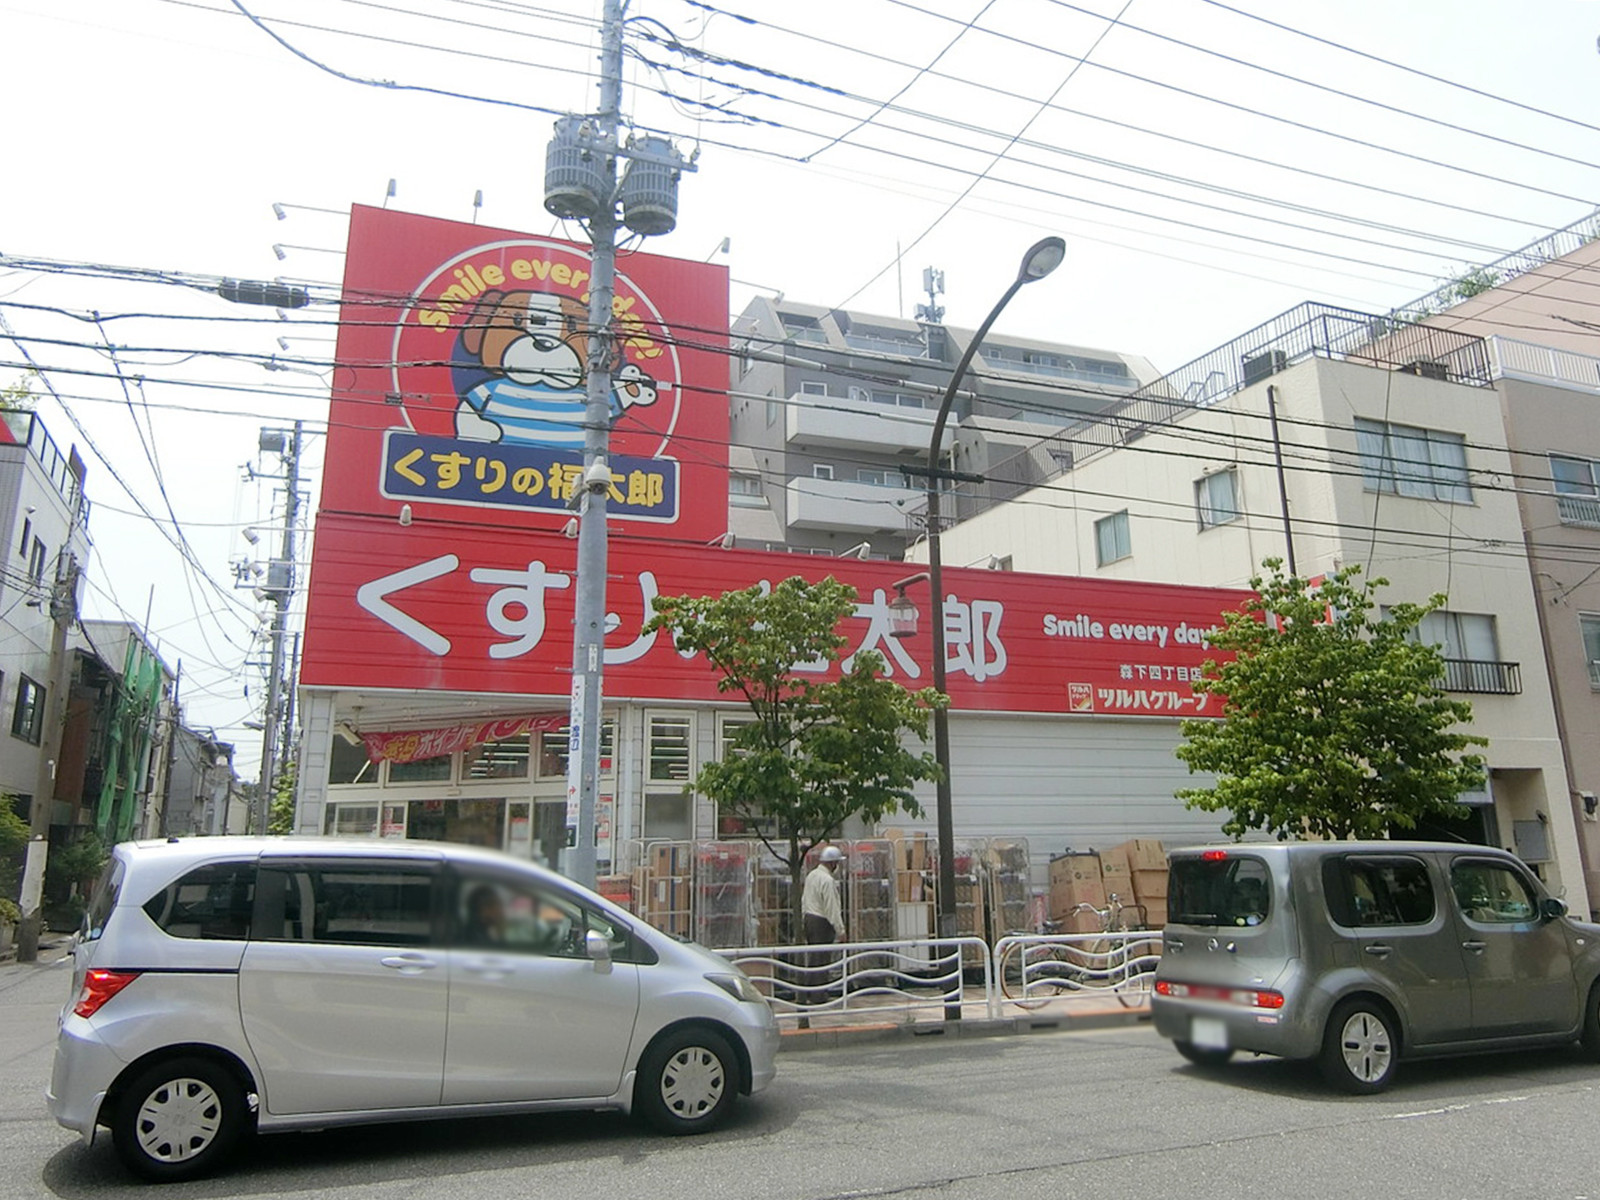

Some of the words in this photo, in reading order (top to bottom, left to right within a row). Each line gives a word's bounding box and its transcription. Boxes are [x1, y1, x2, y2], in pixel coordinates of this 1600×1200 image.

[510, 258, 590, 303] ever
[356, 553, 1008, 682] くすり太郎
[1043, 613, 1104, 639] Smile
[1109, 623, 1168, 649] every
[1119, 664, 1203, 682] 森下四丁目店
[1097, 688, 1208, 711] ツルハグループ
